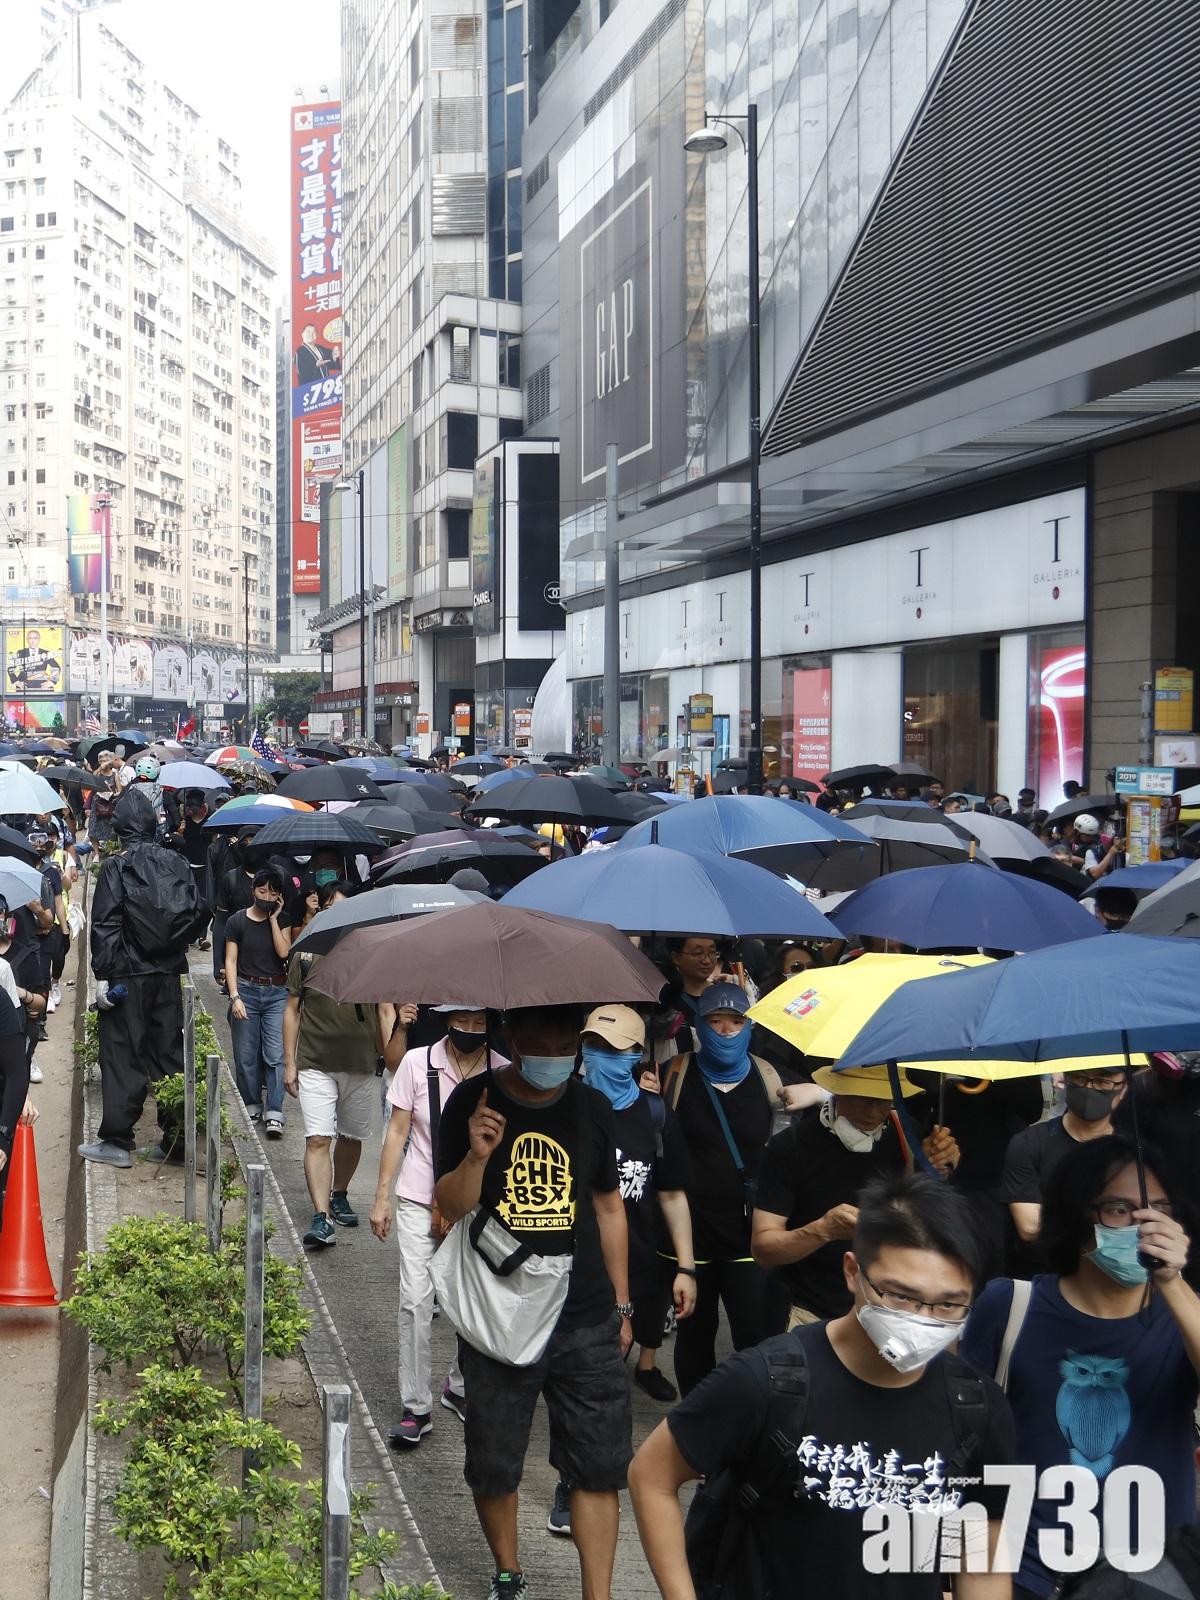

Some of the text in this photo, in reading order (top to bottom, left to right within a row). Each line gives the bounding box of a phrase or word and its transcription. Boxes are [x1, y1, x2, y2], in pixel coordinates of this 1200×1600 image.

[300, 137, 326, 280] 才是真貨
[596, 278, 634, 400] GAP
[1043, 516, 1070, 562] T
[910, 547, 929, 587] T
[1033, 568, 1080, 584] GALLERIA
[474, 590, 491, 607] CHANEL
[799, 572, 815, 606] T
[902, 592, 937, 604] GALLERIA
[680, 600, 691, 628] T
[715, 591, 727, 621] T
[794, 611, 820, 622] GALLERIA
[514, 1138, 566, 1166] MINI
[512, 1161, 567, 1185] CHE
[514, 1186, 566, 1206] BSX
[512, 1217, 568, 1227] WILD SPORTS
[796, 1434, 945, 1485] 原諒我這一生
